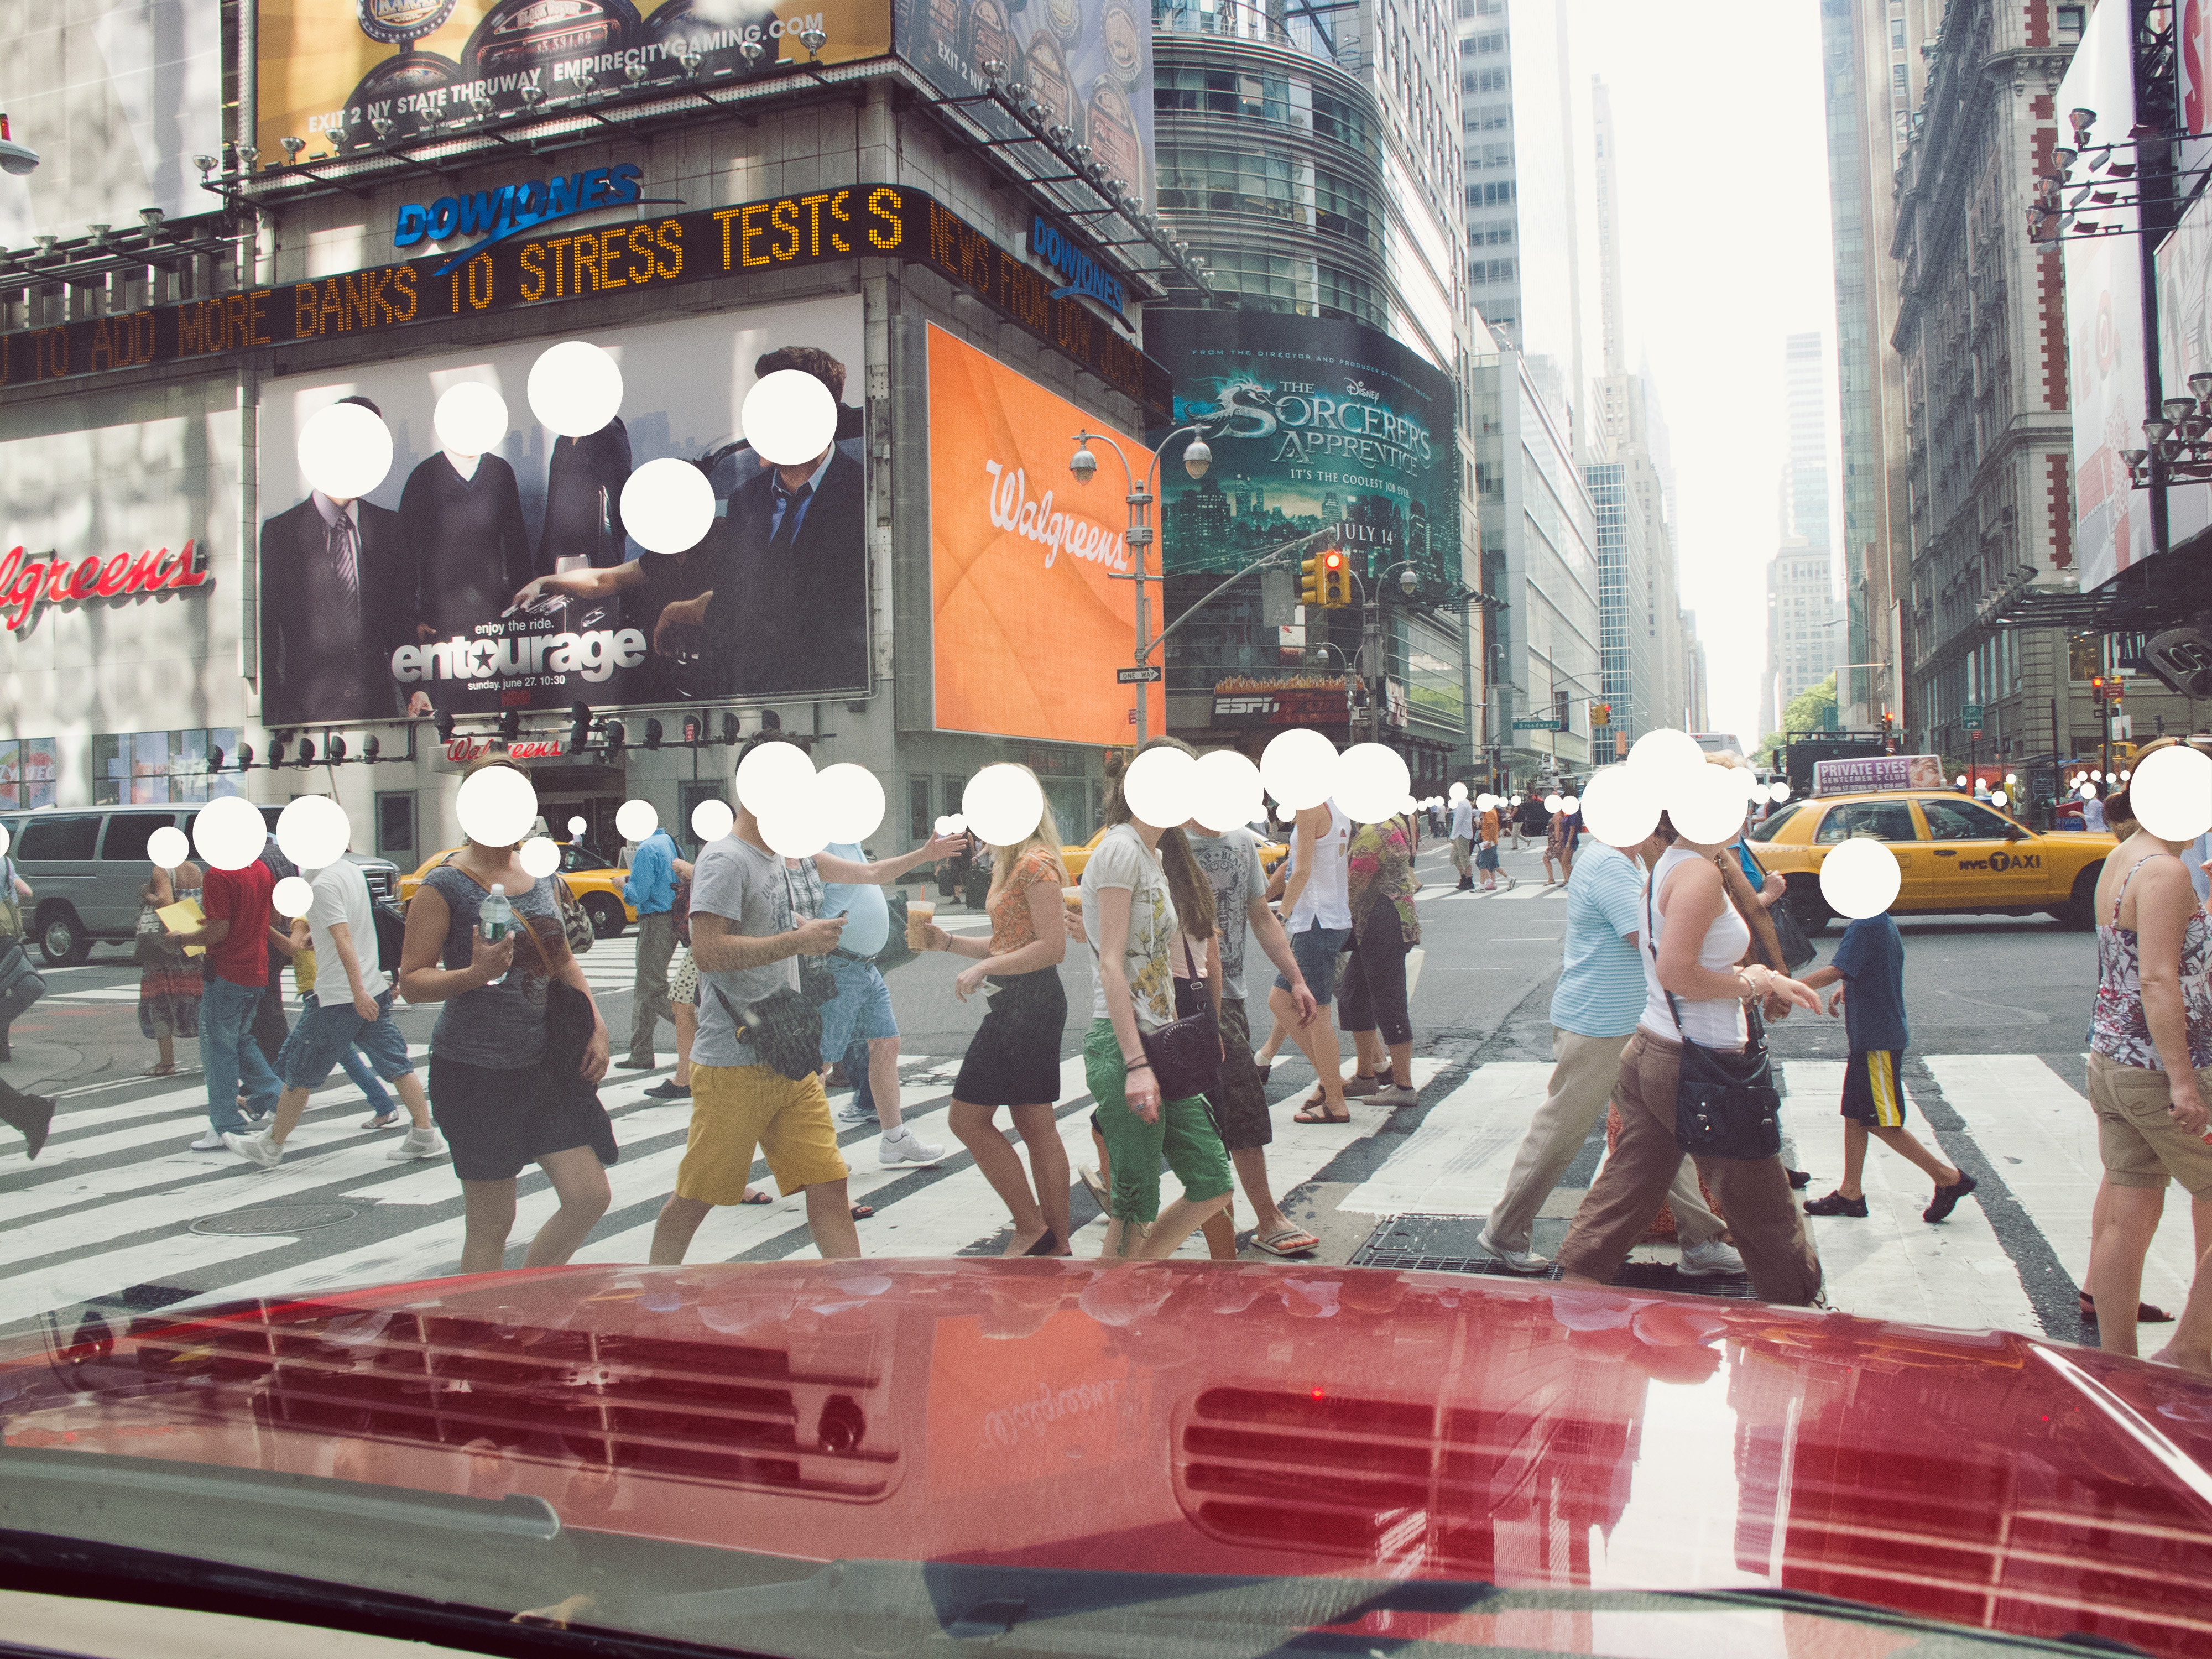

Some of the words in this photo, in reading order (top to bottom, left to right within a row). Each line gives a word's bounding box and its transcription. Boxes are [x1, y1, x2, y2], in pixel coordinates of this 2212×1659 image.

[309, 110, 345, 133] EXIT
[351, 107, 361, 124] 2
[368, 100, 392, 121] NY
[398, 88, 447, 114] STATE
[451, 68, 541, 103] THRUWAY
[554, 12, 823, 81] EMPIRECITYGAMING.COM
[938, 40, 959, 72] EXIT
[962, 61, 968, 80] 2
[970, 69, 983, 92] NY
[930, 200, 989, 294] NEWS
[1001, 252, 1048, 335] FROM
[91, 311, 155, 372] ADD
[178, 289, 270, 357] MORE
[295, 265, 417, 338] BANKS
[521, 220, 682, 301] STRESS
[1258, 350, 1311, 360] DIRECTOR
[1339, 359, 1379, 374] PRODUCER
[1280, 380, 1315, 395] THE
[1194, 377, 1431, 470] SORCERER'S
[1271, 431, 1418, 477] APPRENTICE
[1290, 469, 1312, 481] IT'S
[1317, 471, 1338, 483] THE
[1343, 473, 1383, 489] COOLEST
[1385, 482, 1396, 493] JOB
[985, 459, 1128, 572] Walgreens
[1335, 523, 1375, 542] JULY
[1381, 529, 1393, 545] 14
[0, 539, 207, 631] lgreens
[475, 622, 505, 635] enjoy
[508, 620, 526, 632] the
[530, 618, 554, 630] ride.
[392, 628, 647, 683] entourage
[502, 677, 523, 690] june
[540, 675, 566, 686] 10:30
[1215, 697, 1280, 714] ESPN
[1821, 763, 1874, 777] PRIVATE
[1876, 761, 1907, 775] EYES
[1822, 775, 1881, 784] GENTLEMEN'S
[1959, 860, 1988, 870] NYC
[1989, 851, 2041, 872] TAXI
